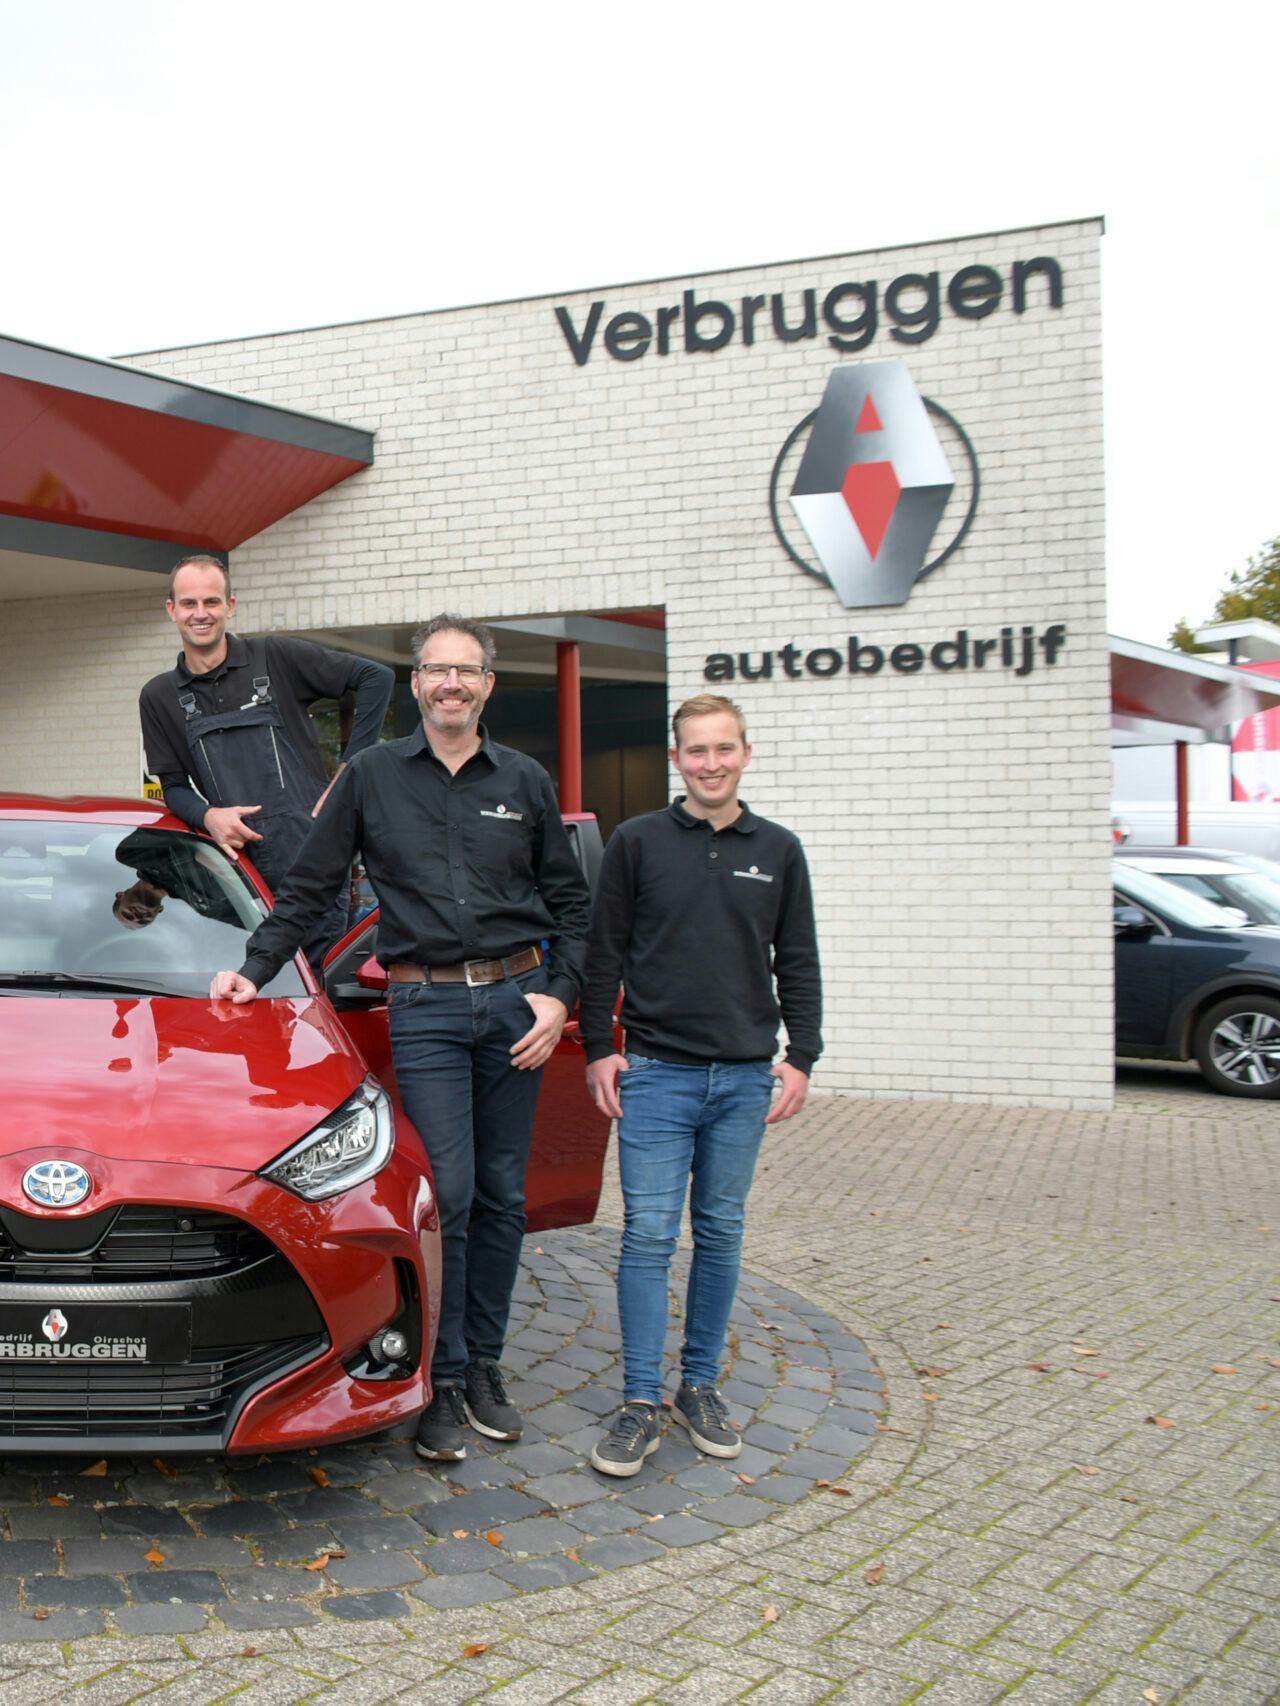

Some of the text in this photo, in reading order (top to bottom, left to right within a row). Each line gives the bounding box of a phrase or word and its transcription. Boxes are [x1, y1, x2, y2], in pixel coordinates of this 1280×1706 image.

[554, 255, 1065, 366] Verbruggen
[703, 623, 1066, 682] autobedrijf
[93, 1335, 147, 1344] Oirschot
